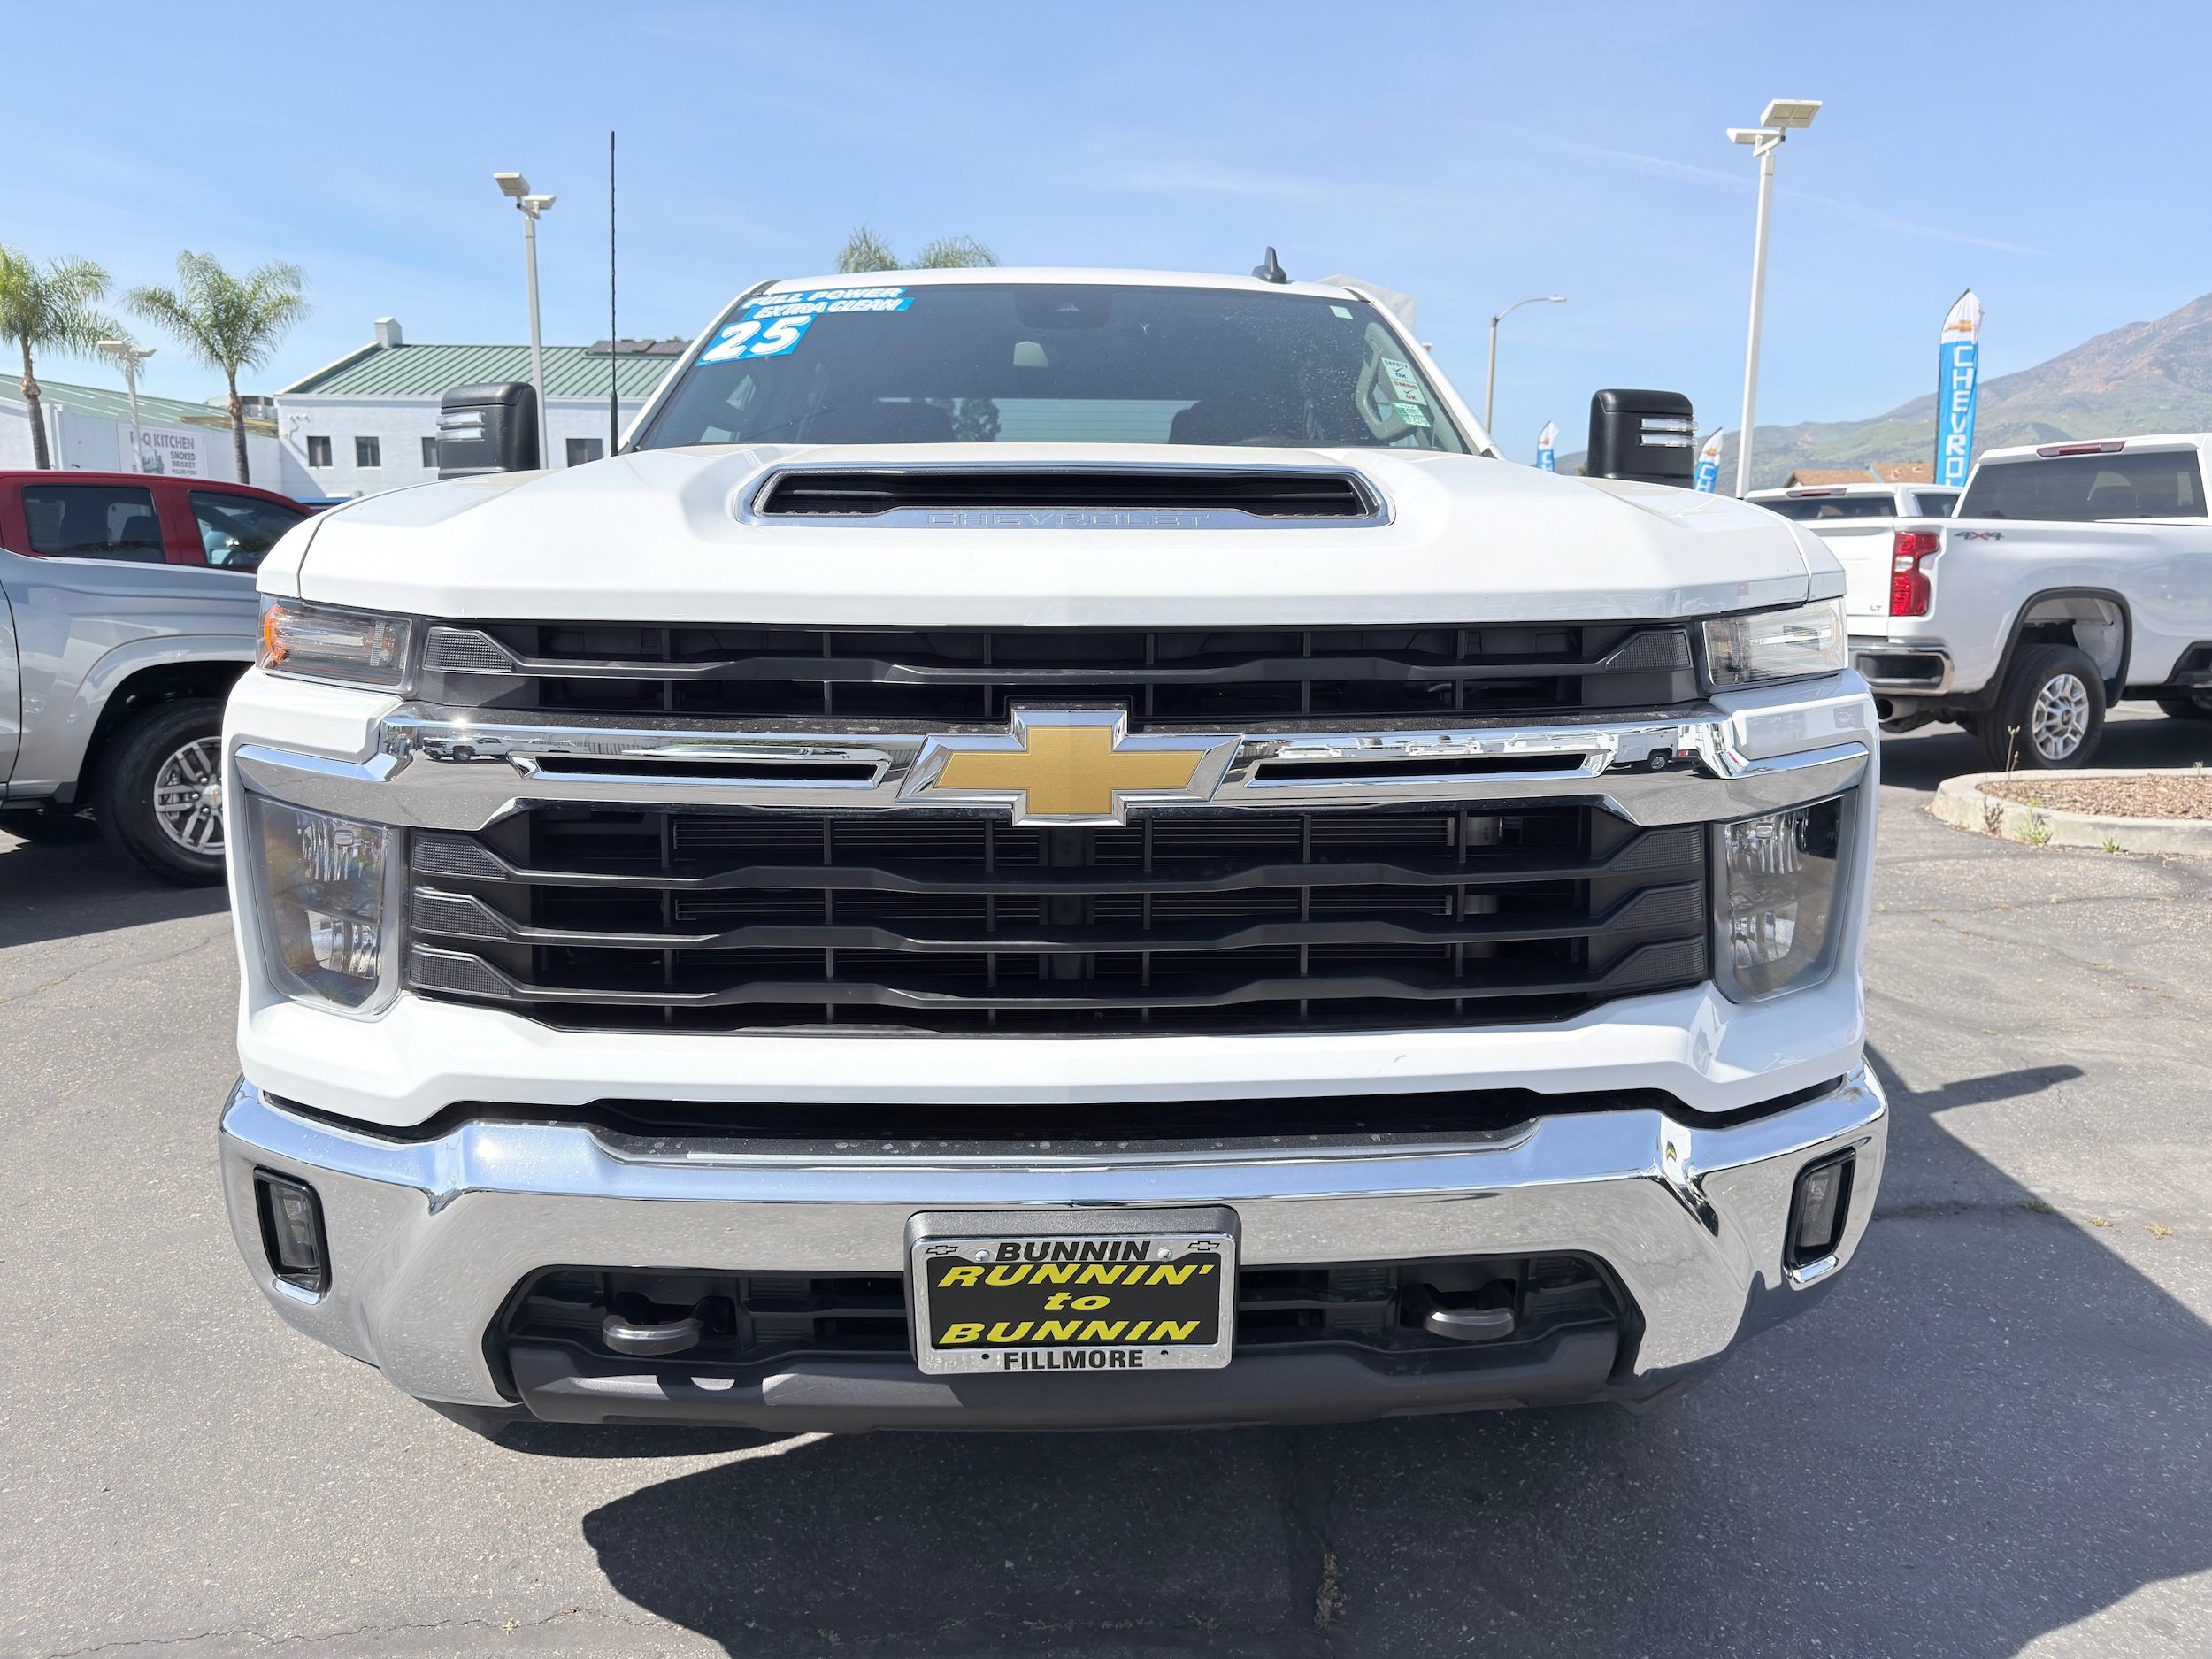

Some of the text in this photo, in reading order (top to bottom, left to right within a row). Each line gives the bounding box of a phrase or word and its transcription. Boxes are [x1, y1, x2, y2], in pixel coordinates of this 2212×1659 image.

[742, 288, 903, 308] FULL POWER
[753, 298, 903, 319] EXTRA CLEAN
[703, 315, 811, 362] 25
[1384, 359, 1409, 369] SAFETY
[153, 434, 195, 449] KITCHEN
[170, 450, 196, 461] SMOKED
[927, 512, 1210, 526] CHEVROLET
[995, 1240, 1151, 1262] BUNNIN
[936, 1263, 1215, 1288] RUNNIN'
[1043, 1292, 1111, 1310] to
[938, 1320, 1201, 1344] BUNNIN
[1003, 1349, 1144, 1370] FILLMORE
